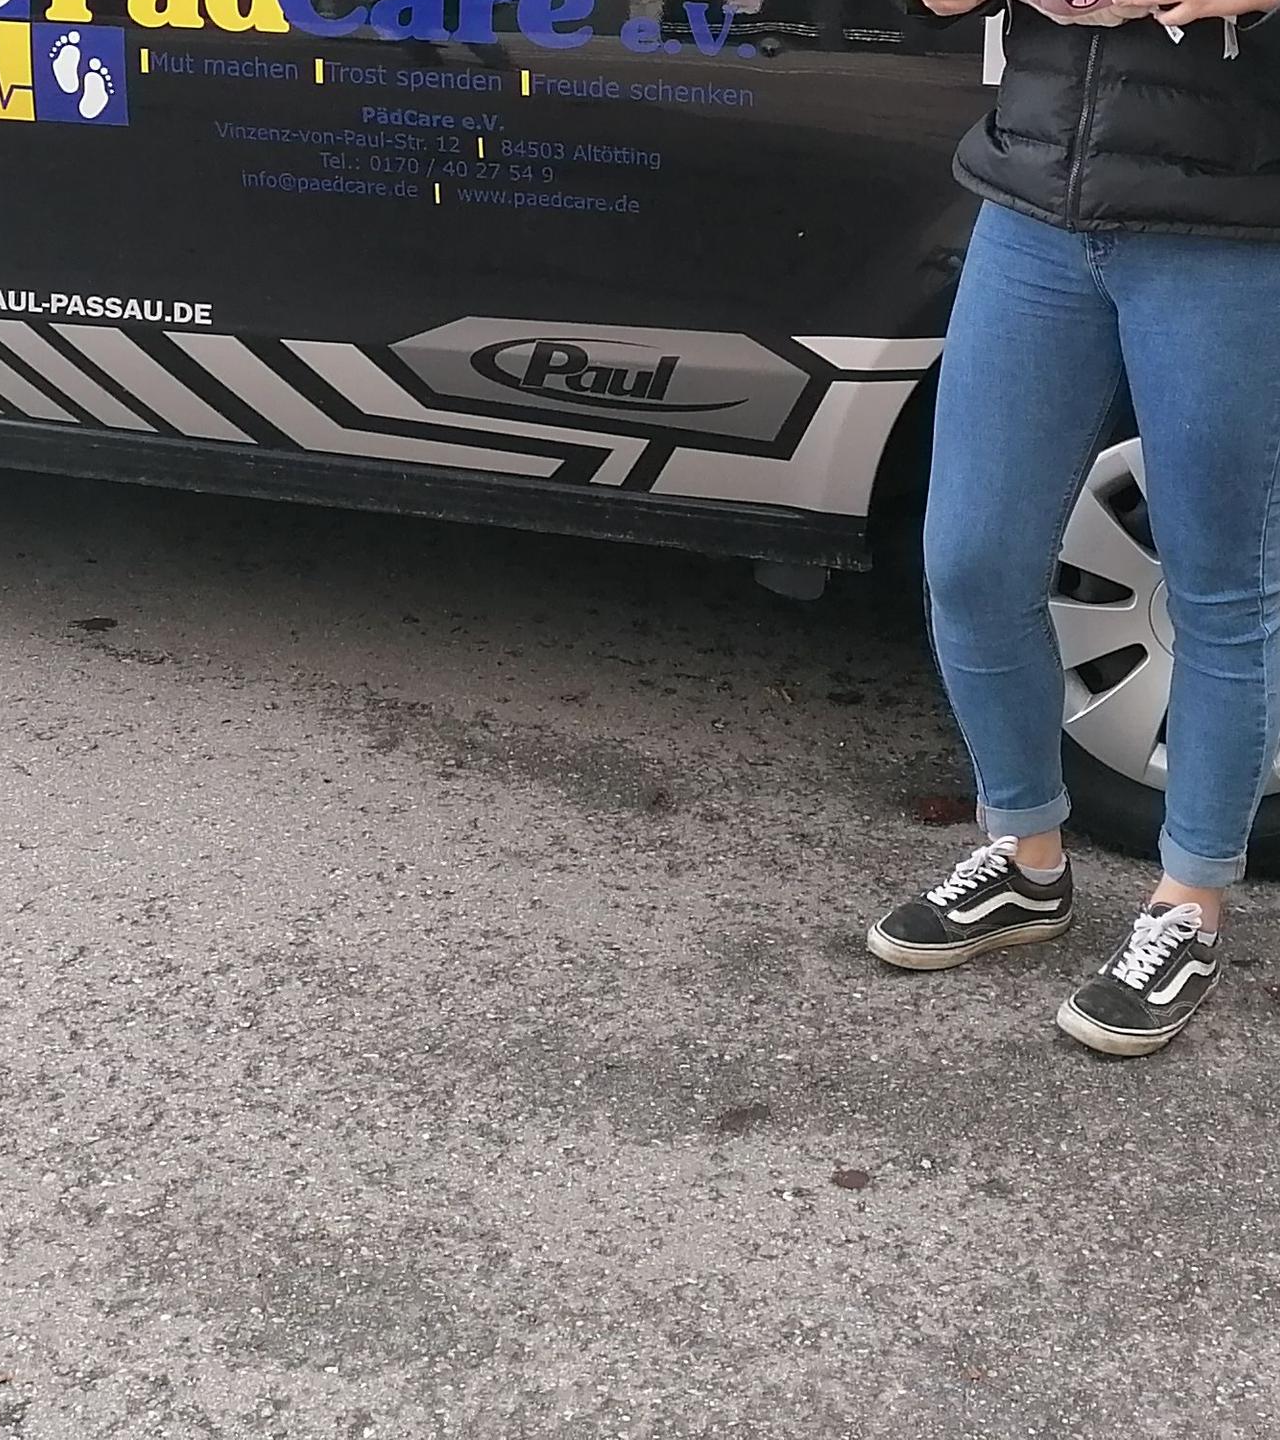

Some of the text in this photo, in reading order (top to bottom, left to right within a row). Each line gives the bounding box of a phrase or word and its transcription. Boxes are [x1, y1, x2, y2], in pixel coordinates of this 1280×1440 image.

[620, 0, 757, 58] e.V.
[150, 52, 755, 107] Mut machen Trost spenden Freude schenken
[361, 106, 505, 131] PädCare e.V.
[215, 121, 661, 171] Vinzenz-von-Paul-Str. 12 84503 Altötting
[320, 152, 360, 172] Tel.:
[369, 157, 420, 175] 0170
[442, 161, 468, 178] 40
[476, 163, 502, 180] 27
[508, 164, 536, 182] 54
[542, 167, 554, 183] 9
[241, 170, 640, 214] info@paedcare.de www.paedcare.de
[523, 338, 678, 402] Paul
